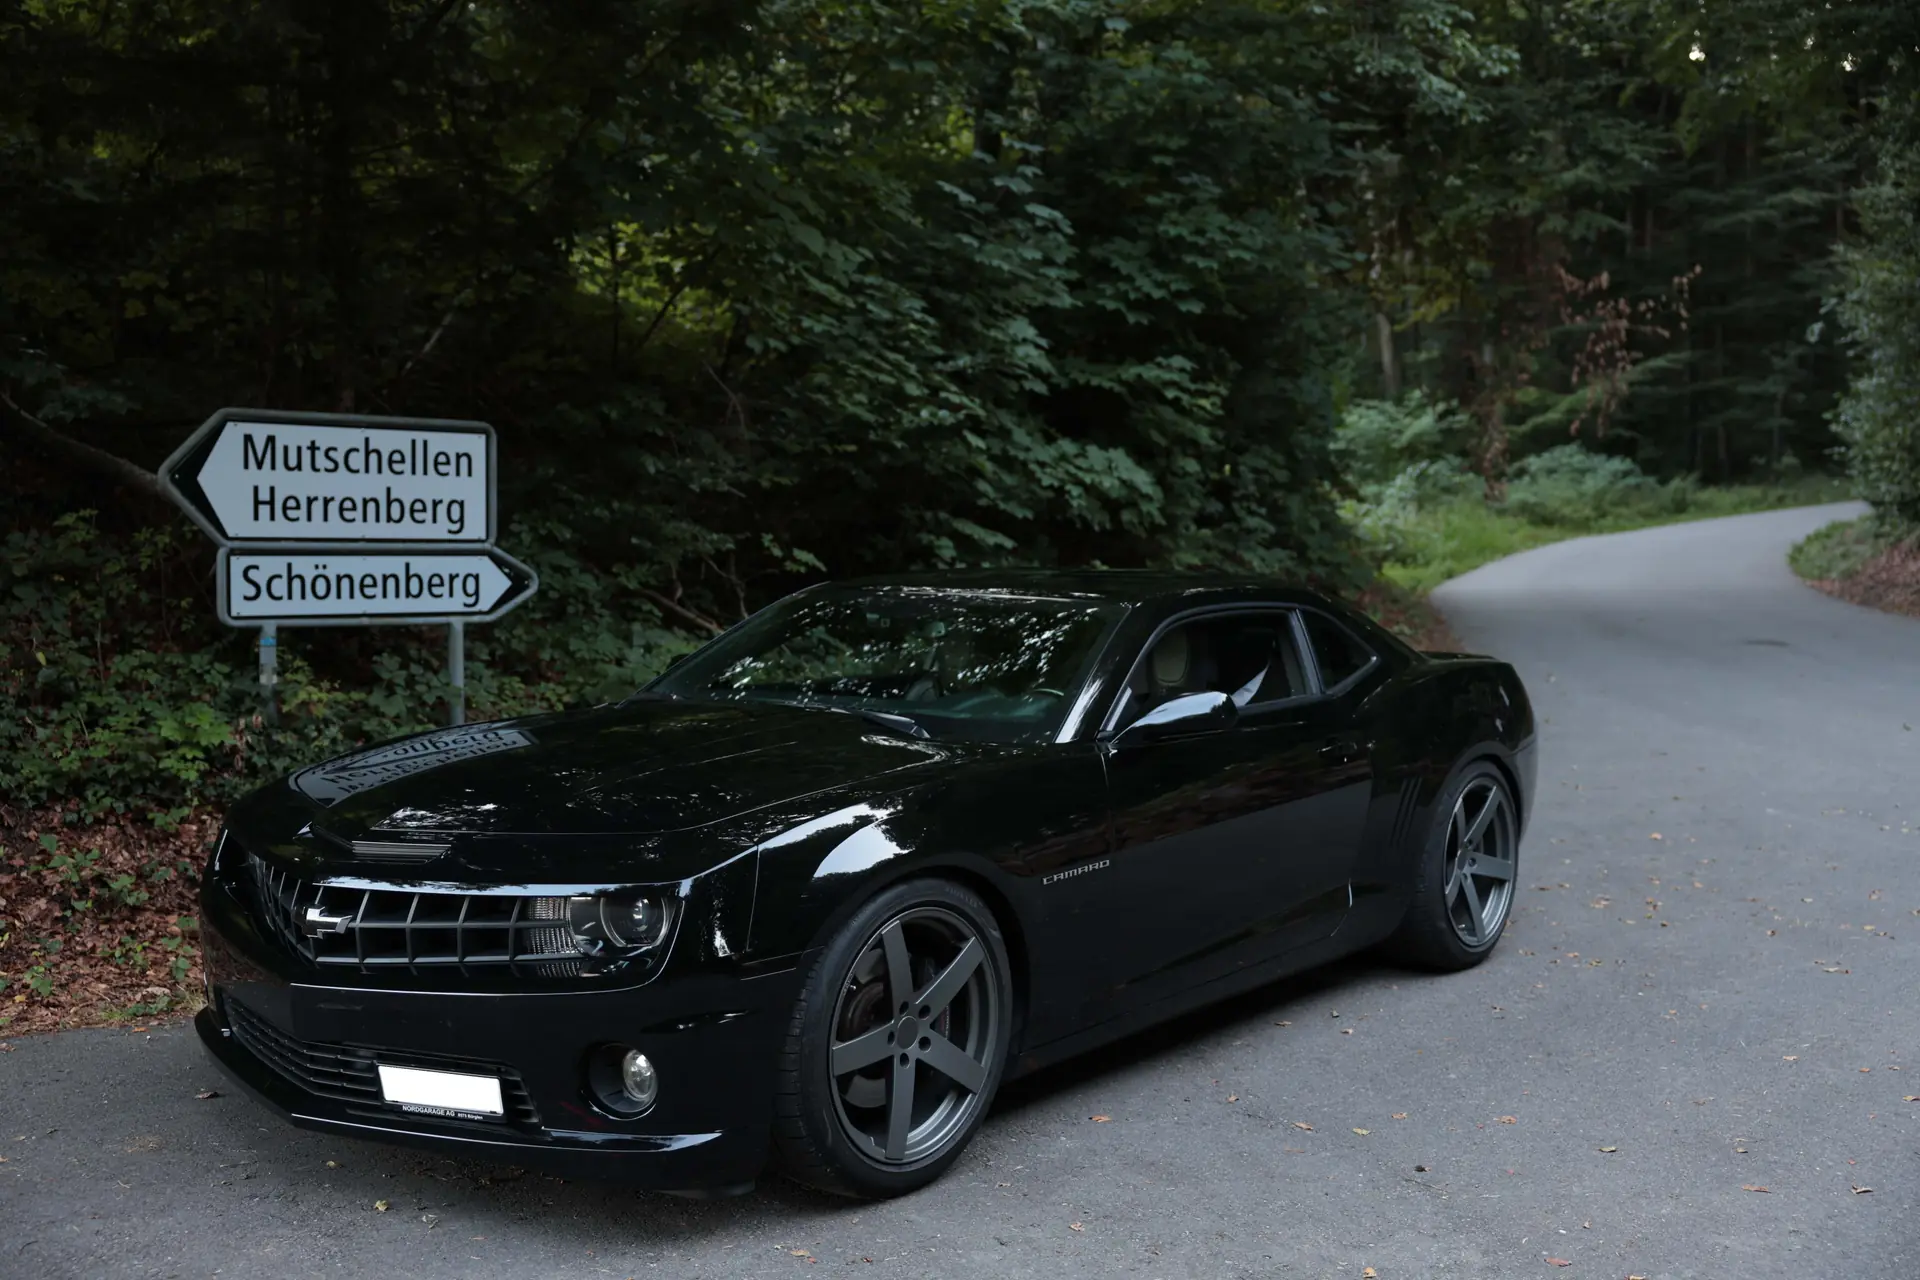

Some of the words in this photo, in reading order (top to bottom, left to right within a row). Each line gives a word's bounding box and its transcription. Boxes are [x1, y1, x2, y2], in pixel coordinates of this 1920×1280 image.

[242, 433, 473, 478] Mutschellen
[252, 485, 466, 535] Herrenberg
[241, 562, 481, 608] Schönenberg
[1042, 859, 1110, 885] CAMARO
[402, 1104, 445, 1116] NORDGARAGE
[445, 1109, 456, 1118] AG
